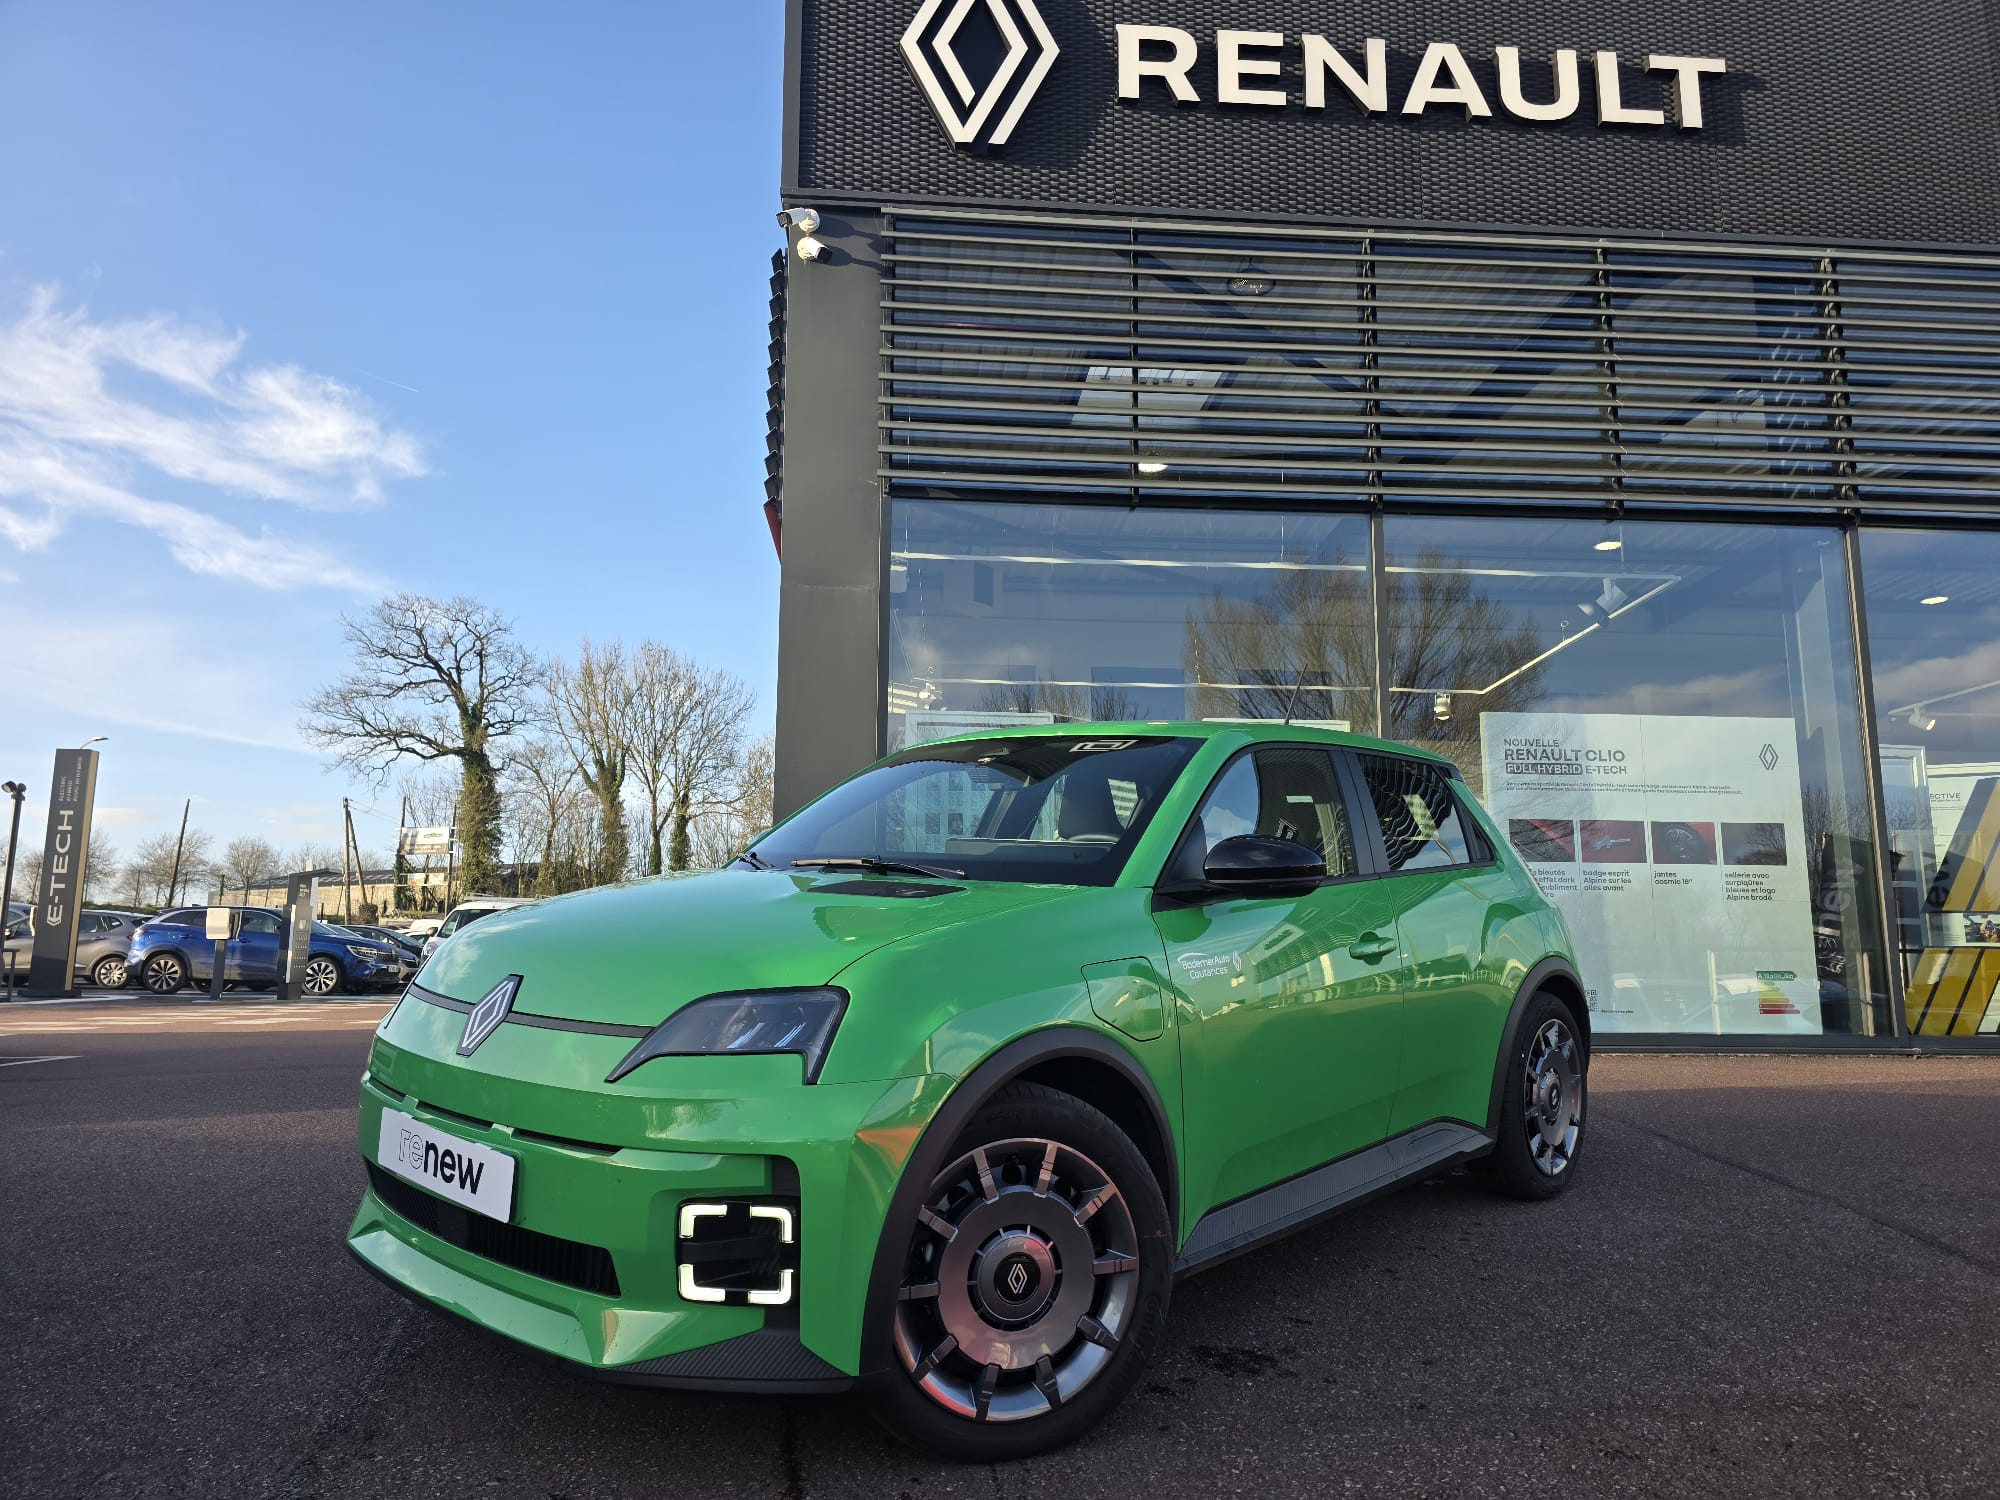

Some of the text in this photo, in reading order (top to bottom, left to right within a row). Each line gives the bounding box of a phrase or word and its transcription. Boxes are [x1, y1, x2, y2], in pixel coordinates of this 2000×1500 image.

[1115, 23, 1727, 129] RENAULT
[1503, 738, 1560, 748] NOUVELLE
[1504, 748, 1626, 762] RENAULT CLIO
[1507, 763, 1627, 775] FULL HYBRID E-TECH
[46, 809, 74, 927] E-TECH
[1582, 869, 1630, 878] badge esprit
[1653, 870, 1677, 879] jantes
[1724, 871, 1751, 879] sellerie
[1583, 877, 1607, 885] Alpine
[1759, 886, 1776, 894] logo
[1189, 966, 1228, 980] Coutances
[398, 1128, 485, 1195] renew
